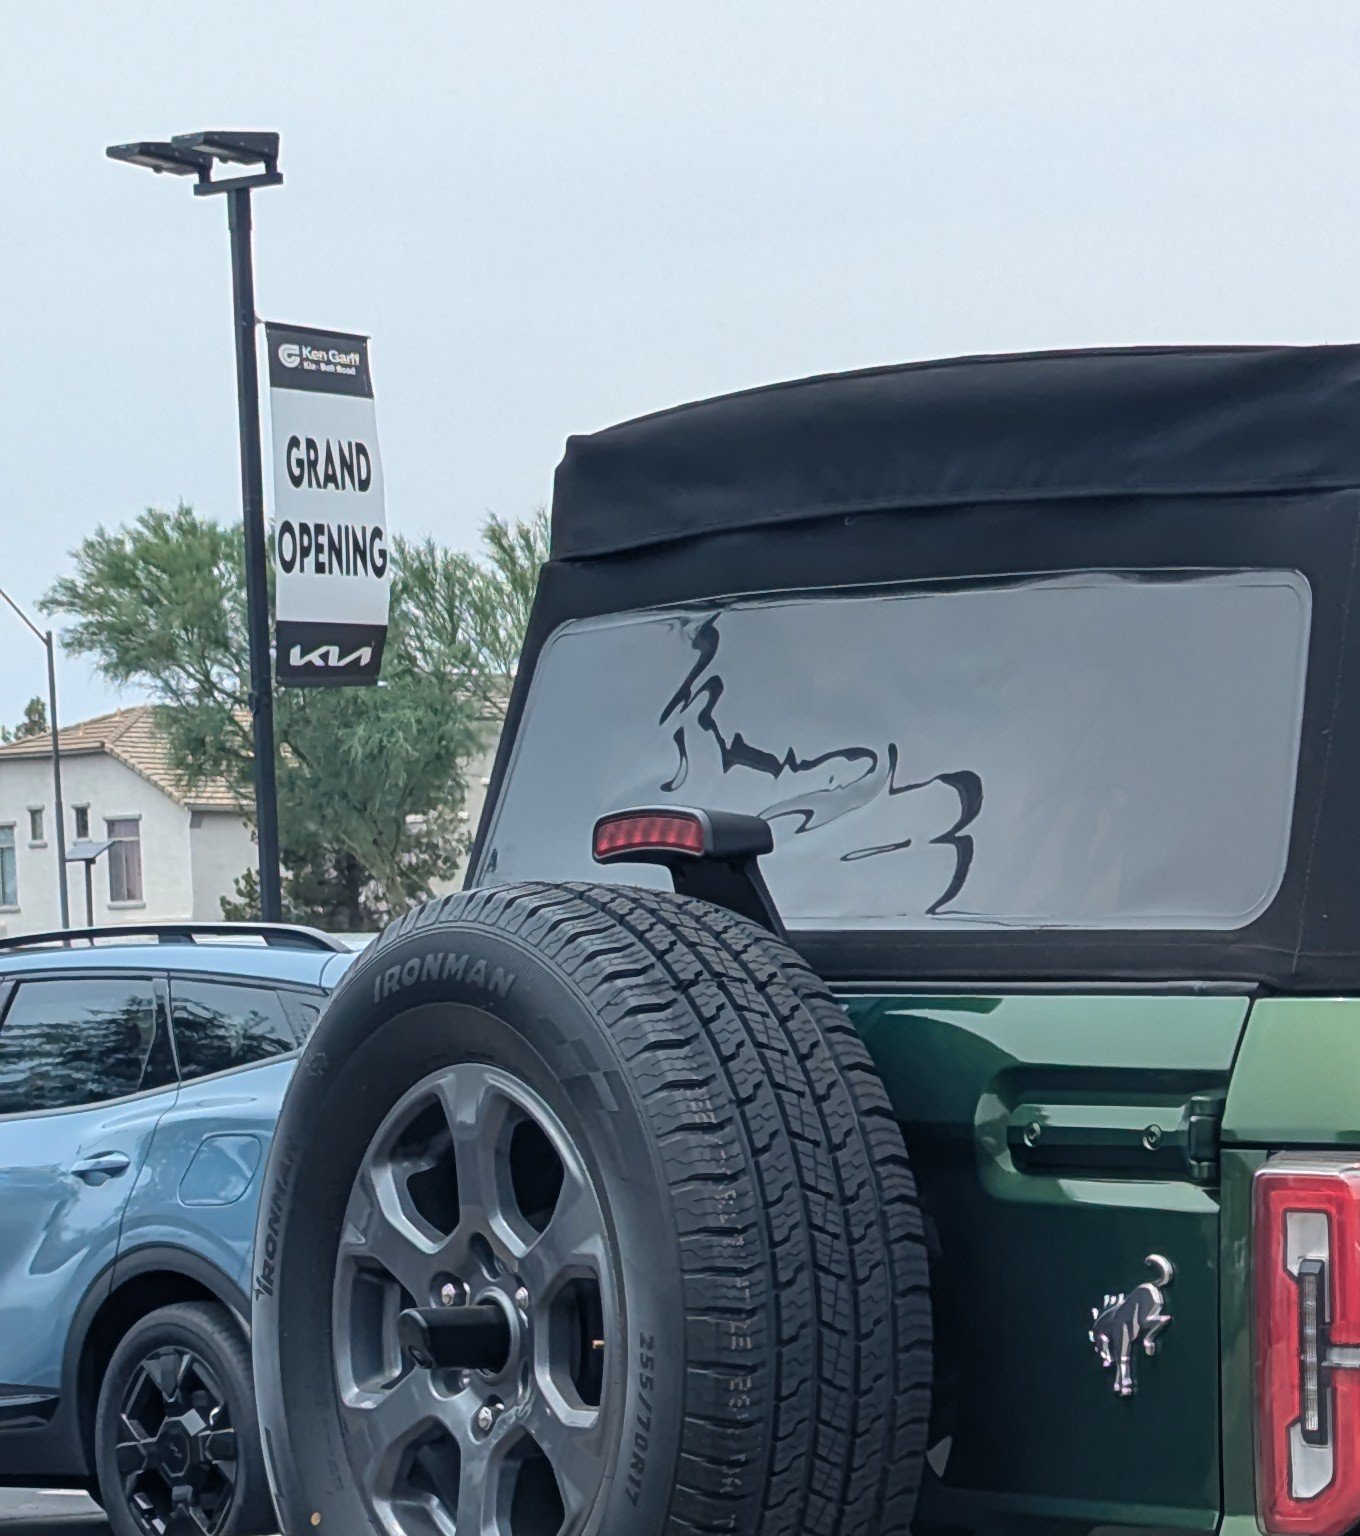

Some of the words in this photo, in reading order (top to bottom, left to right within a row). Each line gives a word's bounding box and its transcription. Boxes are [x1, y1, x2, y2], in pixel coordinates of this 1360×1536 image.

[302, 345, 327, 361] Ken
[328, 349, 359, 367] Garff
[286, 435, 372, 493] GRAND
[277, 520, 388, 579] OPENING
[373, 952, 516, 1004] IRONMAN
[625, 1331, 655, 1507] 255/70R17
